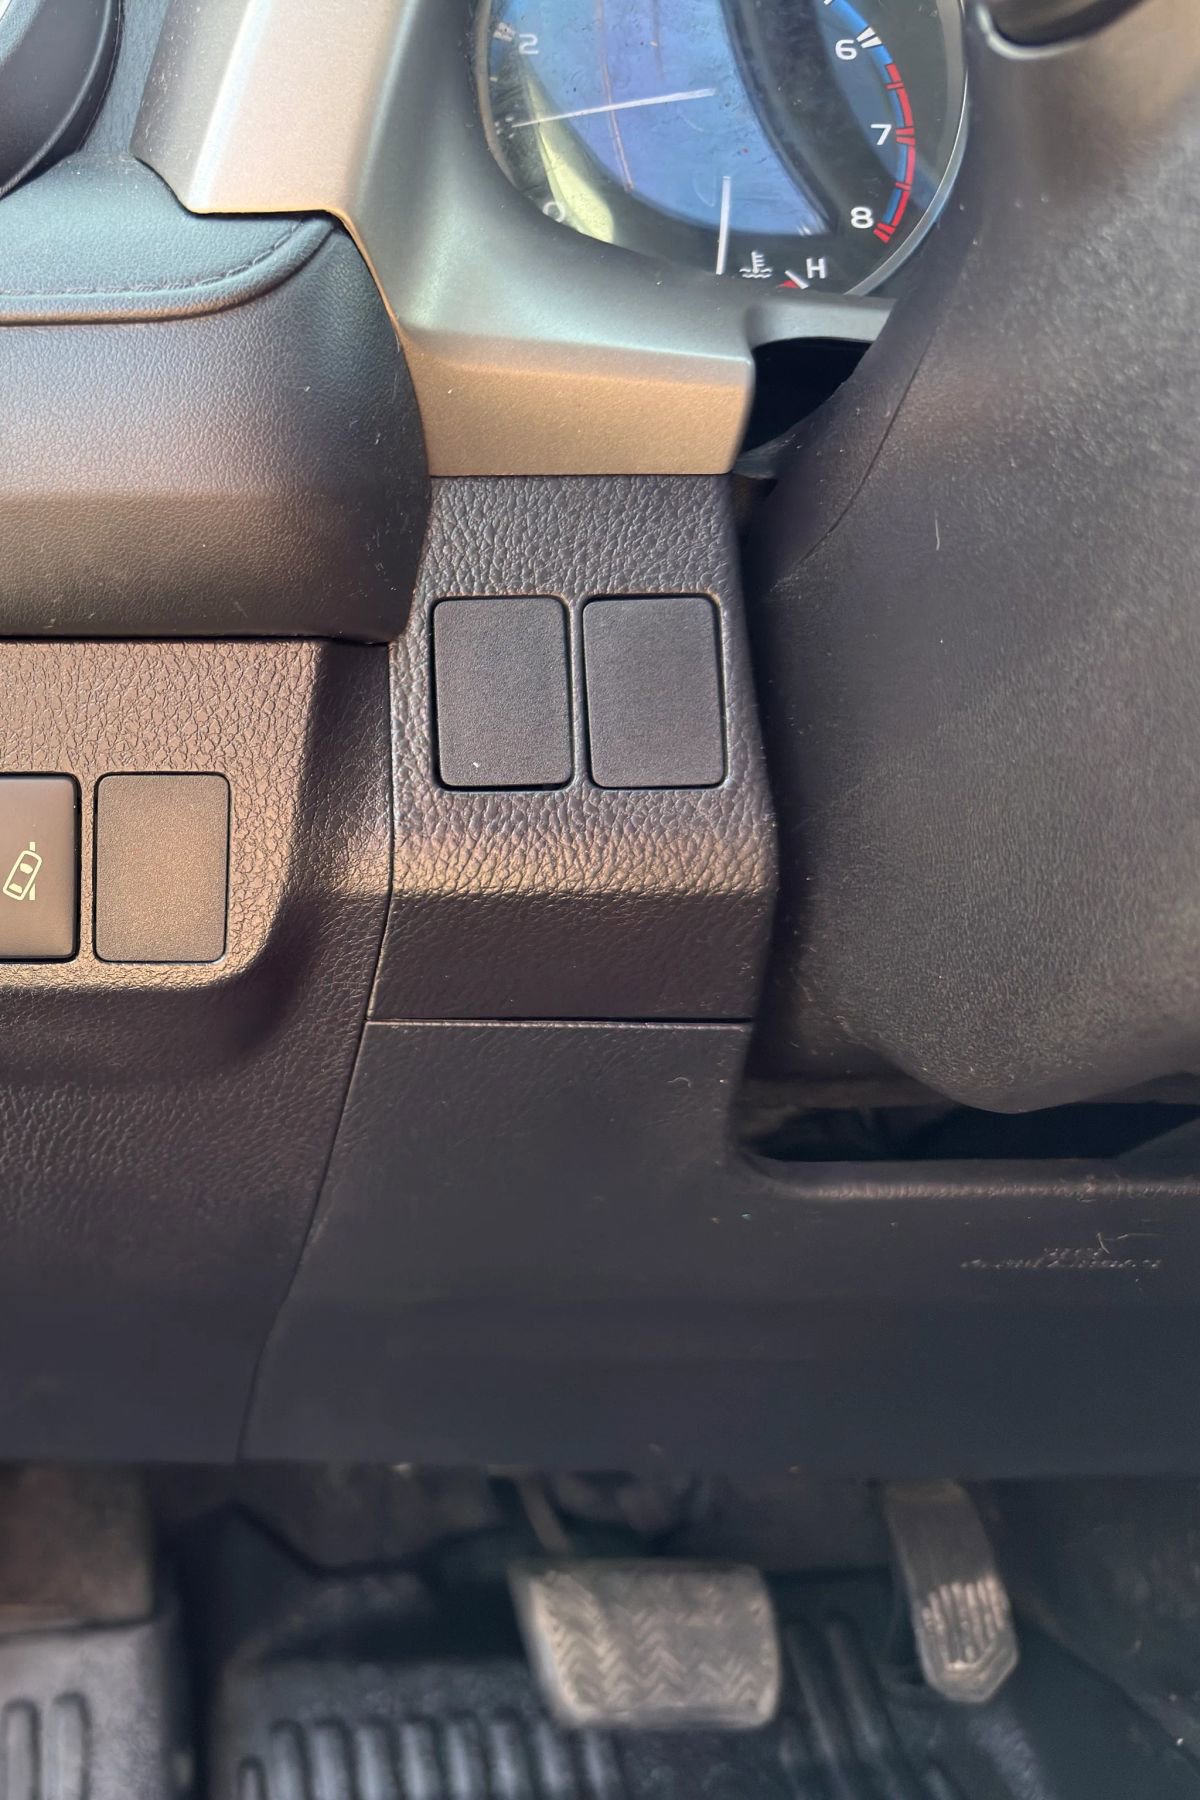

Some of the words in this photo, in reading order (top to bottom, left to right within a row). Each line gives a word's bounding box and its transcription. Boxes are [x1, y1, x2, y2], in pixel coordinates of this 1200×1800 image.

[518, 33, 539, 55] 2
[835, 39, 858, 60] 6
[870, 123, 892, 146] 7
[850, 206, 874, 229] 8
[805, 257, 827, 279] H
